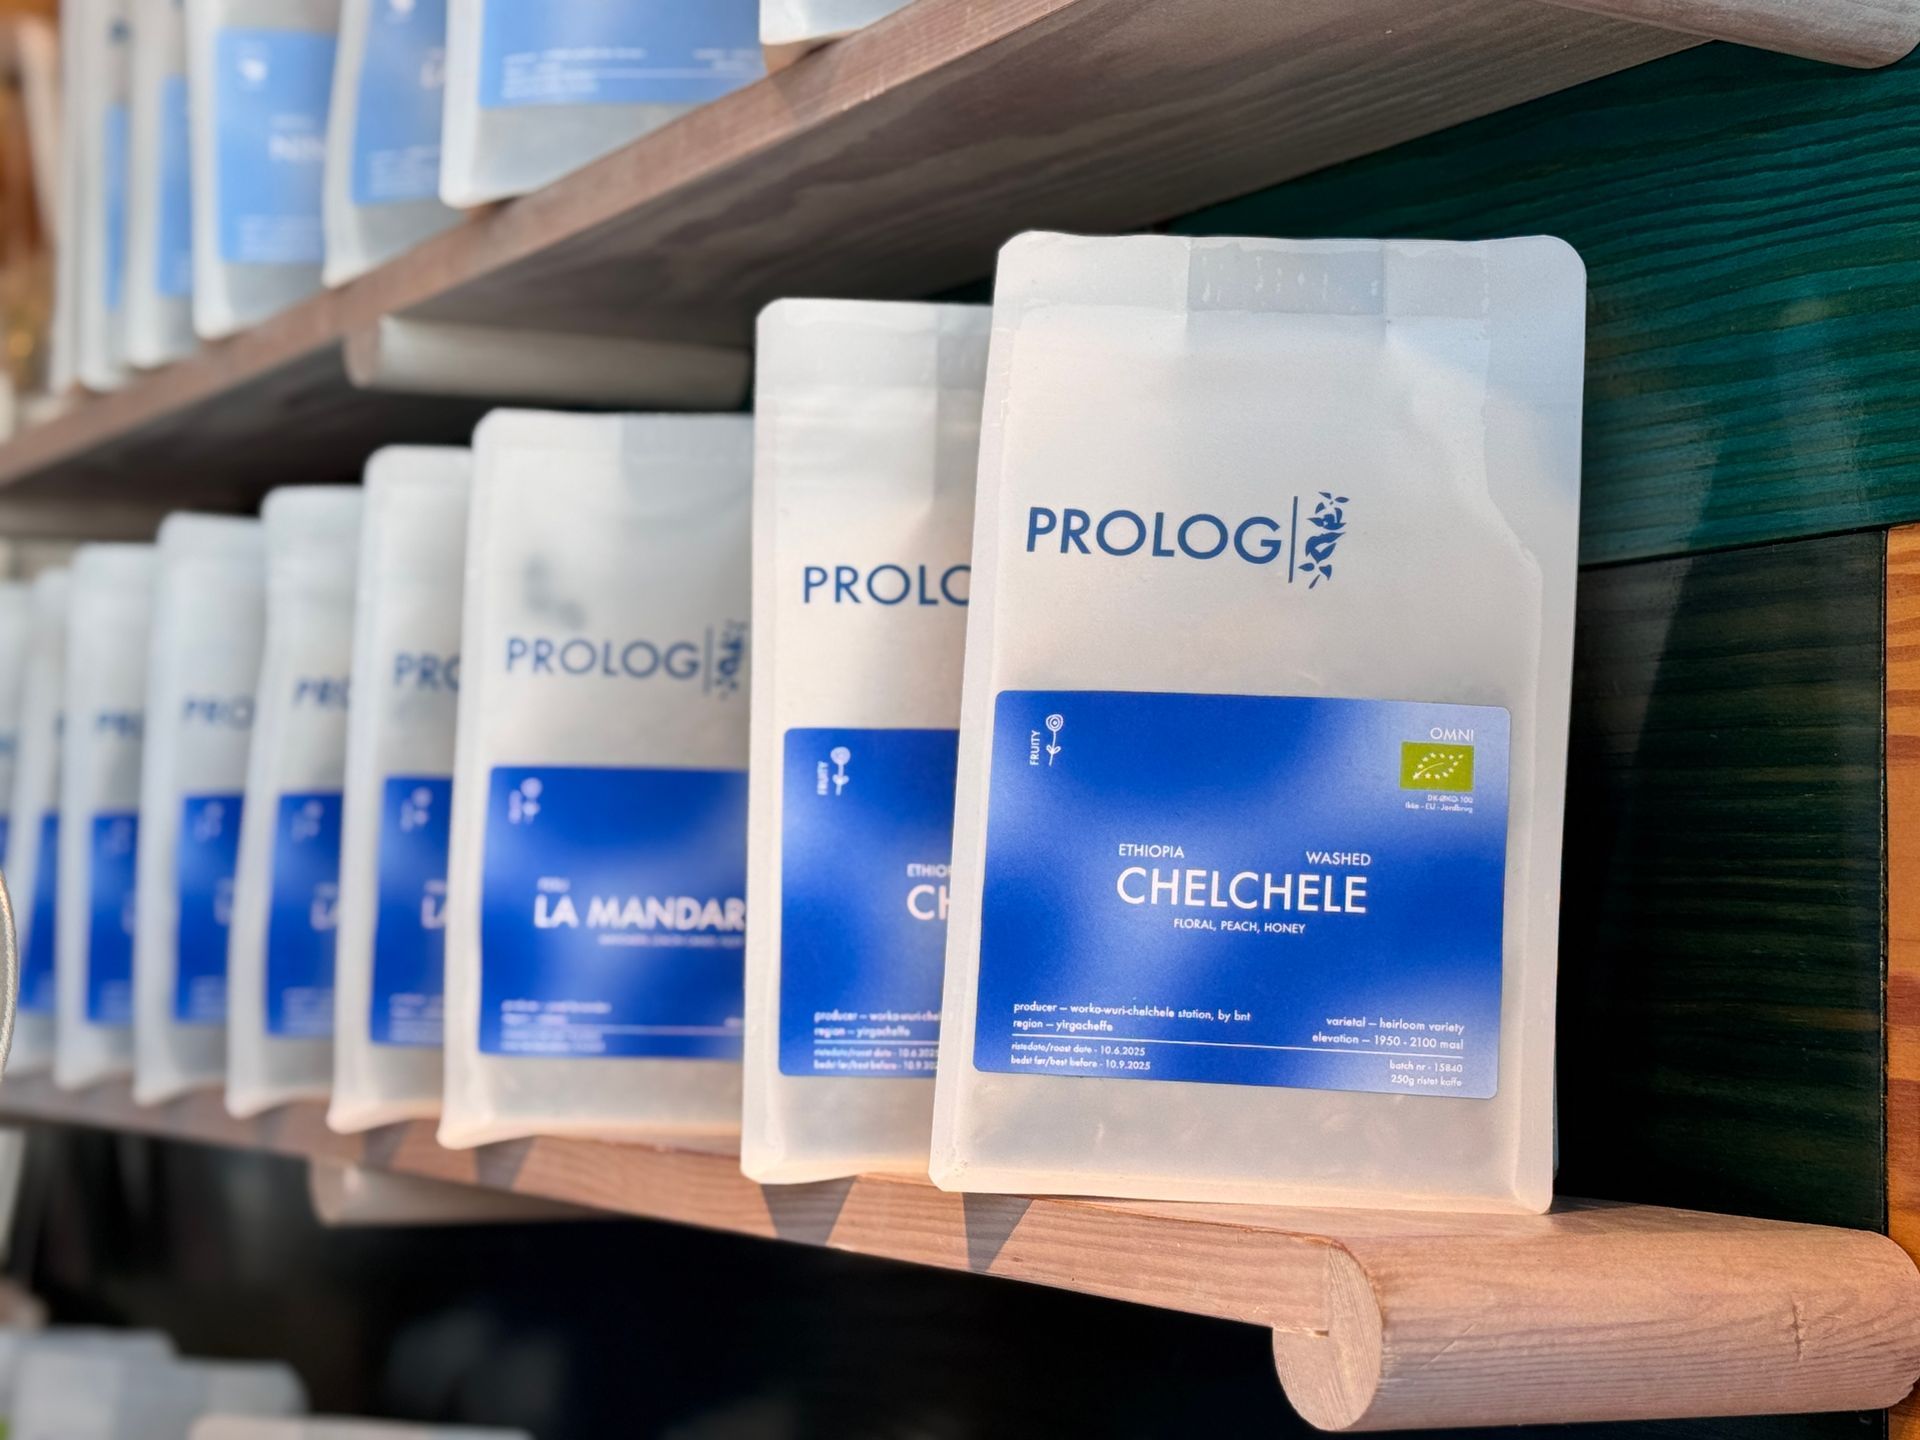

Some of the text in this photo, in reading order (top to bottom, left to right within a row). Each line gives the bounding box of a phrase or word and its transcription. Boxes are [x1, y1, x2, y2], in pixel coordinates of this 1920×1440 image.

[1026, 506, 1283, 565] PROLOG
[506, 637, 699, 681] PROLOG
[1430, 727, 1474, 741] OMNI
[1029, 730, 1041, 766] FRUITY
[1118, 843, 1185, 858] ETHIOPIA
[1306, 851, 1371, 866] WASHED
[1116, 866, 1368, 914] CHELCHELE
[534, 894, 747, 932] LA MANDAR
[1174, 918, 1306, 935] FLORAL, PEACH, HONEY
[1013, 1001, 1058, 1013] producer
[1070, 1003, 1175, 1018] worka-wuri-chelchele
[1178, 1010, 1214, 1021] station,
[1217, 1009, 1232, 1022] by
[1233, 1010, 1251, 1020] bnt
[1013, 1018, 1044, 1031] region
[1056, 1020, 1113, 1032] yirgacheffe
[1326, 1016, 1366, 1028] varietal
[1379, 1016, 1425, 1031] heirloom
[1428, 1021, 1465, 1035] variety
[1312, 1031, 1359, 1044] elevation
[1374, 1035, 1401, 1046] 1950
[1409, 1037, 1437, 1048] 2100
[1440, 1039, 1464, 1050] masl
[1073, 1045, 1092, 1053] date
[1100, 1045, 1146, 1056] 10.6.2025
[1010, 1056, 1033, 1065] bedst
[1069, 1058, 1098, 1068] before
[1105, 1059, 1151, 1070] 10.9.2025
[1389, 1059, 1415, 1070] batch
[1434, 1062, 1463, 1073] 15840
[1391, 1074, 1462, 1087] 250g ristet kaffe
